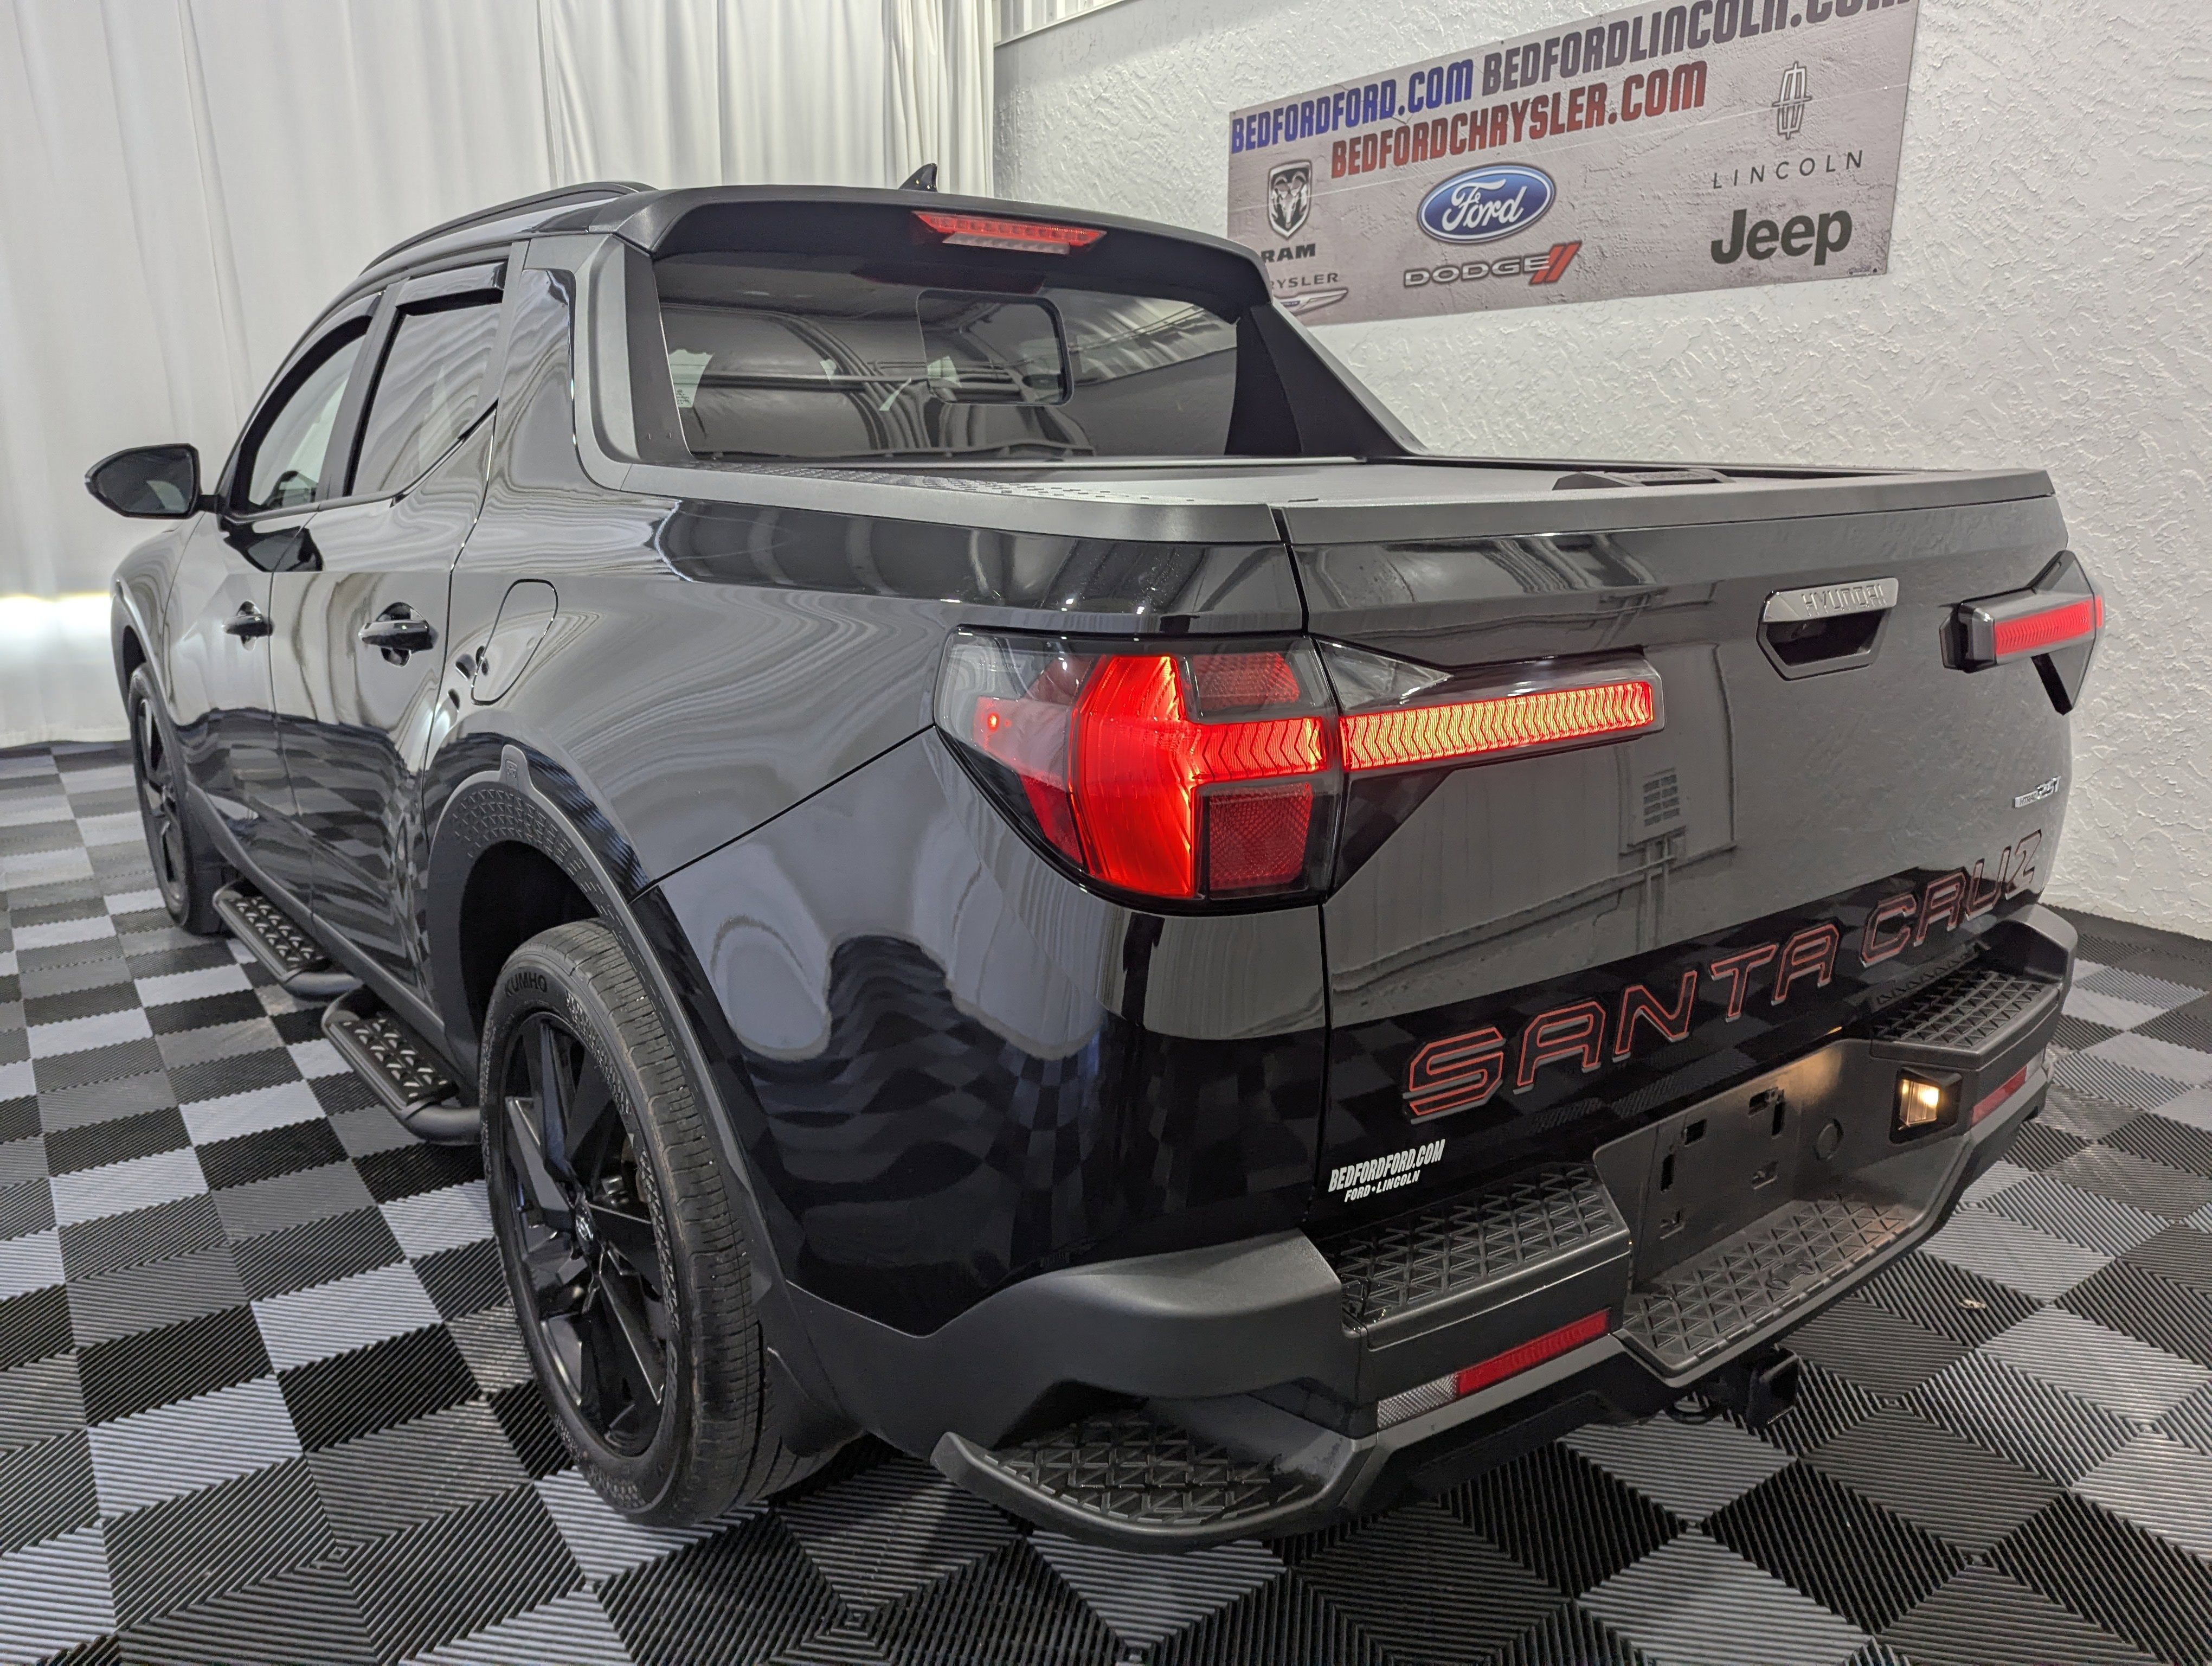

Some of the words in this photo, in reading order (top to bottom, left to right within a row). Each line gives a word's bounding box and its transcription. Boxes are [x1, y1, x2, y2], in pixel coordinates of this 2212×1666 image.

[1231, 59, 1473, 154] BEDFORDFORD.COM
[1331, 60, 1707, 178] BEDFORDCHRYSLER.COM
[1713, 150, 1863, 189] LINCOLN
[1441, 178, 1527, 230] Ford
[1261, 244, 1316, 262] RAM
[1711, 208, 1853, 266] Jeep
[1404, 255, 1551, 288] DODGE
[1801, 584, 1888, 617] HYUNDAI
[504, 971, 548, 997] KUMHO
[1403, 923, 1841, 1124] SANTA
[1328, 1139, 1445, 1193] BEDFORDFORD.COM
